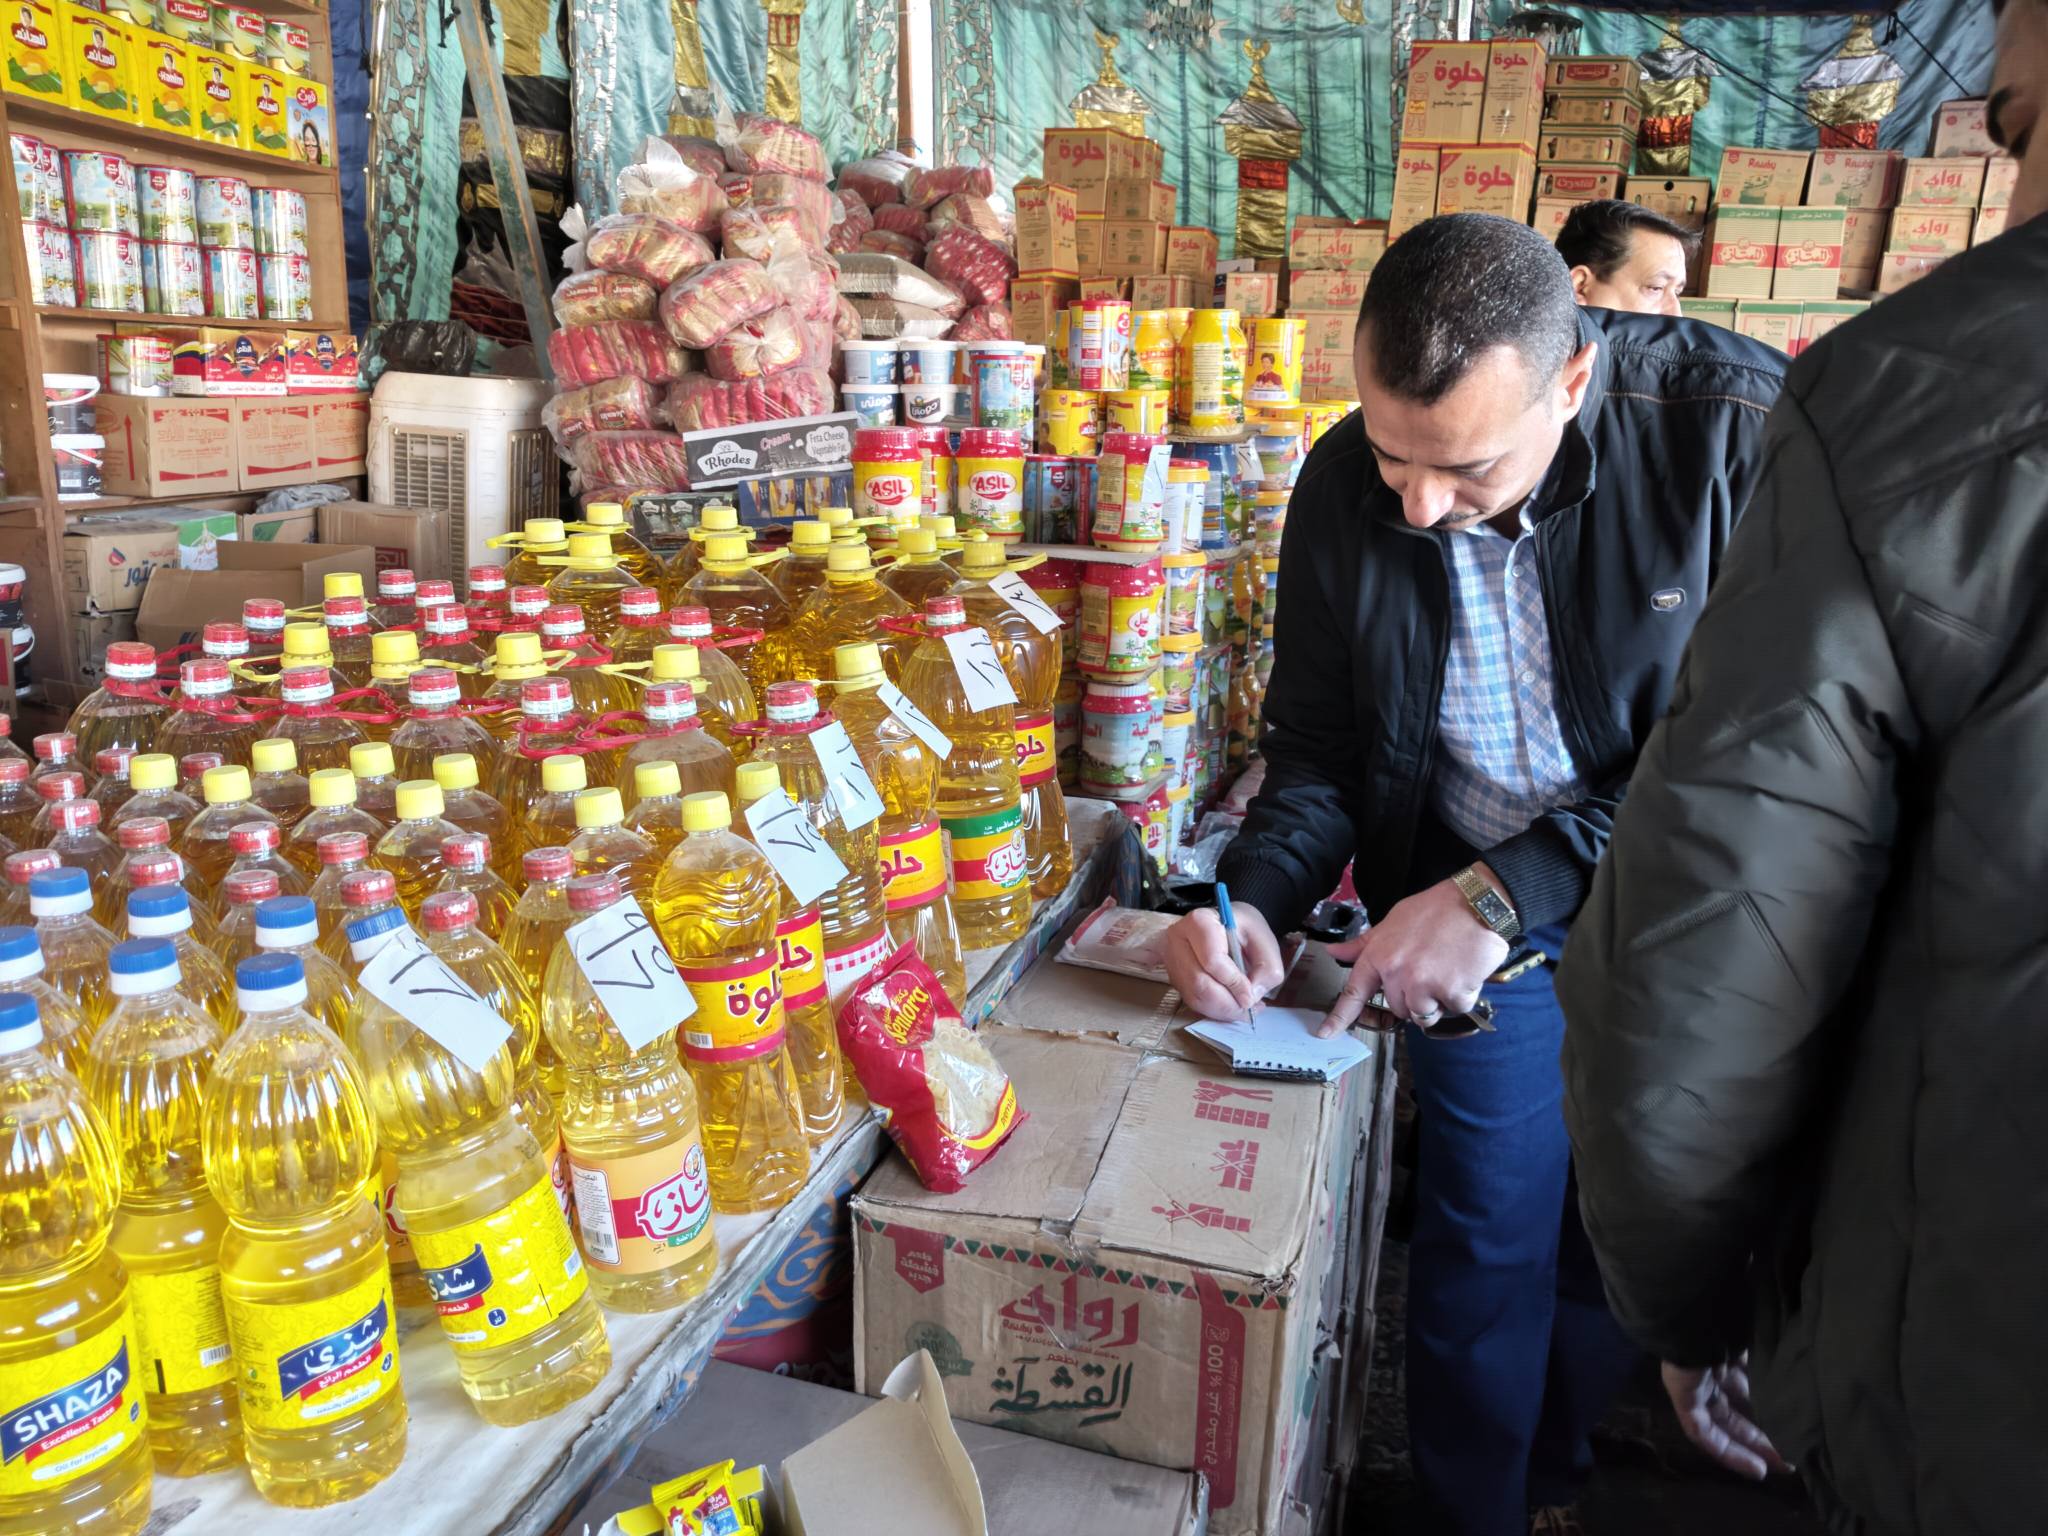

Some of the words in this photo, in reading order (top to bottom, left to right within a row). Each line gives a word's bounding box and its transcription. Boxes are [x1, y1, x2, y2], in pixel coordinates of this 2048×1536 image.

[1434, 59, 1485, 91] حلوة
[1492, 52, 1529, 71] حلوة
[1059, 139, 1105, 168] حلوة
[1402, 157, 1435, 175] حلوة
[1463, 164, 1515, 194] حلوة
[824, 431, 846, 442] Cheese
[704, 451, 752, 470] Rhodes
[14, 1366, 124, 1443] SHAZA
[40, 1422, 91, 1451] Excellent
[90, 1406, 116, 1427] Taste
